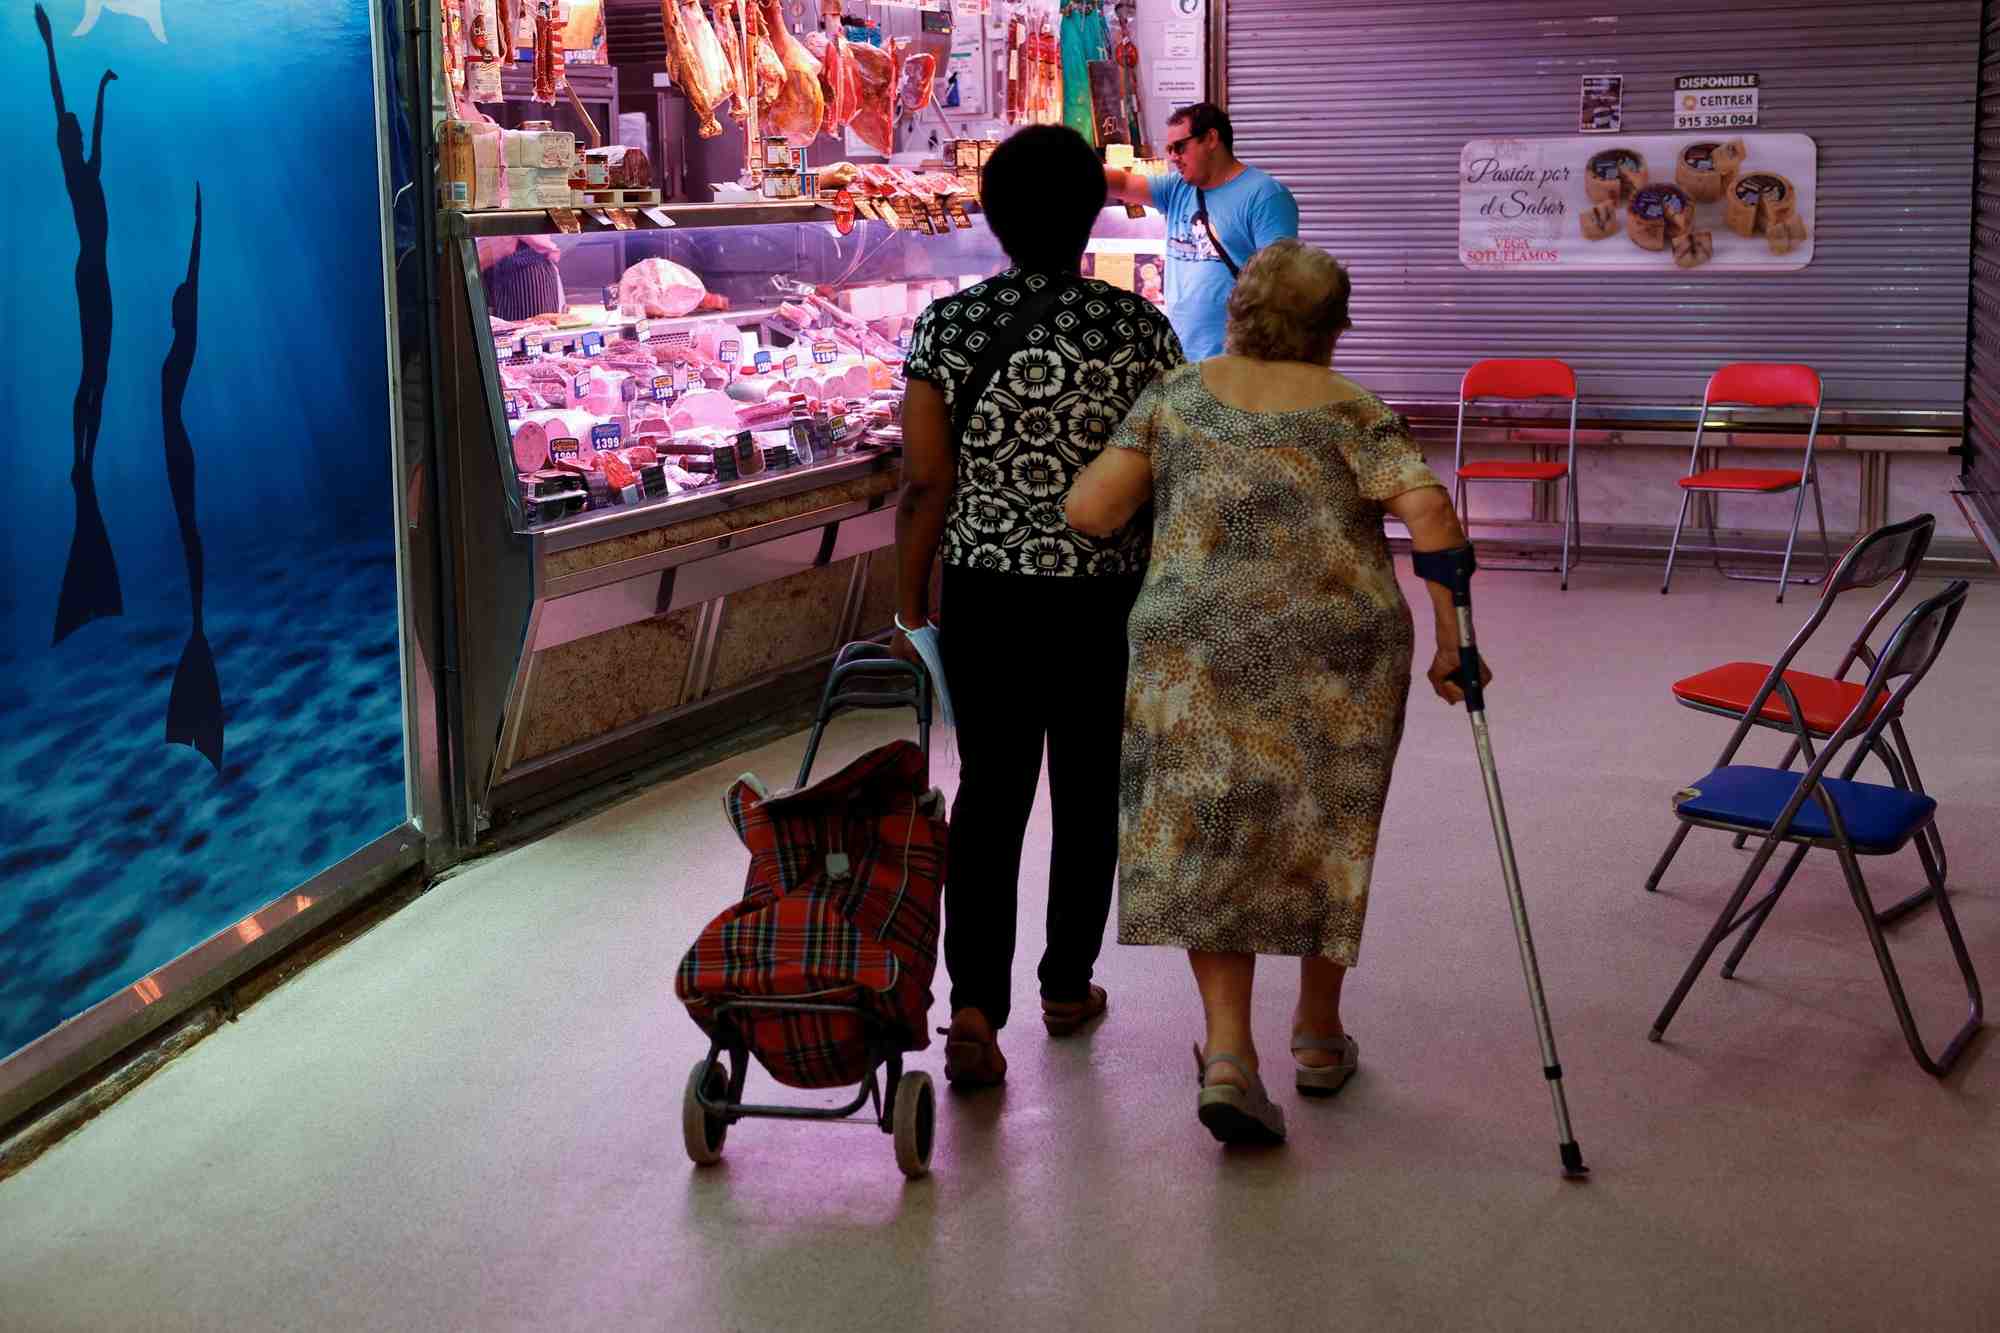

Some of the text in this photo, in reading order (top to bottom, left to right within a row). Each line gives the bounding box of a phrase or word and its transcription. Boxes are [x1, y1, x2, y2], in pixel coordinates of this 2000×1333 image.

[1679, 75, 1756, 89] DISPONIBLE
[1679, 114, 1753, 127] 915 394 094
[1467, 158, 1571, 188] Pasión por
[1480, 190, 1566, 218] el Sabor
[1494, 239, 1530, 249] VEGA
[595, 437, 619, 449] 1399
